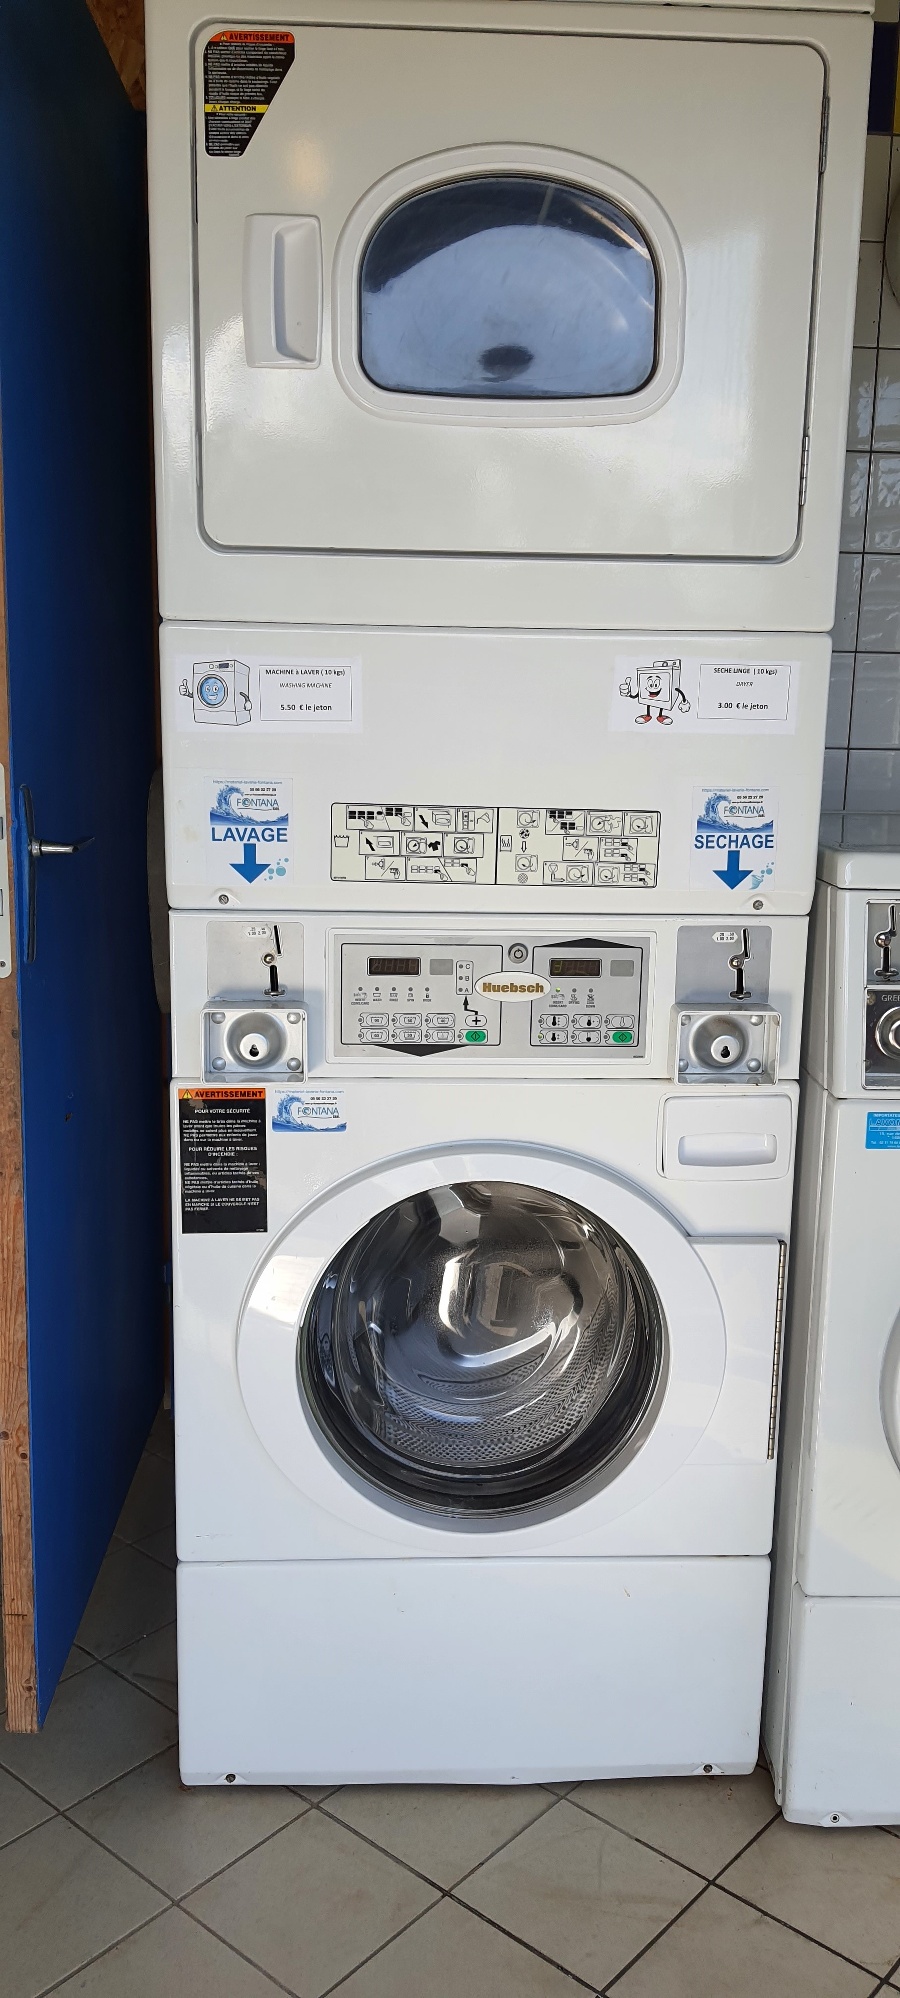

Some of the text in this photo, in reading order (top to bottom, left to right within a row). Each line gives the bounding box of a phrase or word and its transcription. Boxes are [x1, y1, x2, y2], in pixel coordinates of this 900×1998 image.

[212, 827, 287, 842] LAVAGE
[695, 835, 774, 849] SECHAGE
[483, 983, 544, 992] Huebsch
